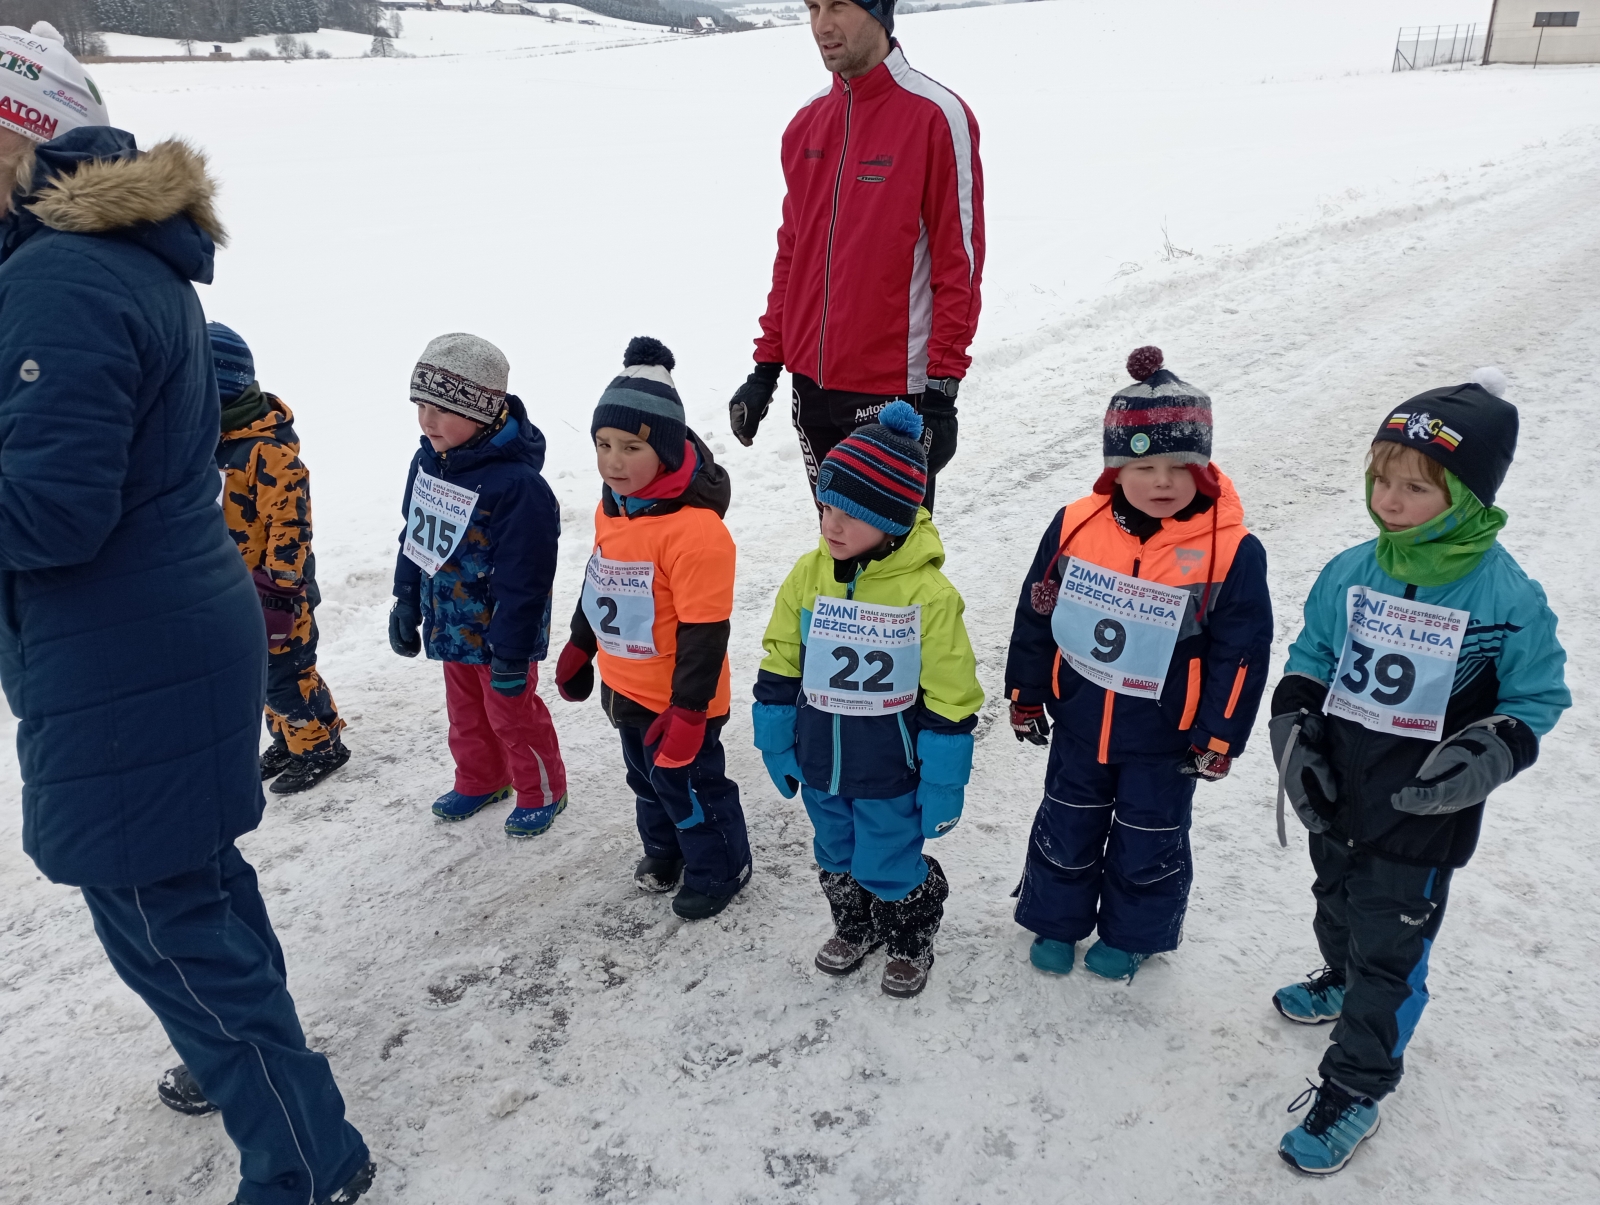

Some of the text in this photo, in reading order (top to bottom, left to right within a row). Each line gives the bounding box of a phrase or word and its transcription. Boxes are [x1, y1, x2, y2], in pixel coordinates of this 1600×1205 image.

[446, 502, 467, 518] LIGA
[412, 507, 457, 558] 215
[621, 578, 648, 589] LIGA
[1069, 564, 1117, 591] ZIMNÍ
[1123, 581, 1139, 590] KRÁLE
[1065, 580, 1177, 620] BĚŽECKÁ LIGA
[1117, 586, 1181, 606] 2025-2026
[596, 597, 621, 635] 2
[817, 603, 858, 620] ZIMNÍ
[860, 615, 916, 624] 2025-2026
[1387, 611, 1459, 632] 2025-2026
[1394, 606, 1409, 614] KRÁLE
[1410, 610, 1446, 621] JESTŘEBÍCH
[1448, 616, 1460, 624] HOR
[814, 618, 916, 638] BĚŽECKÁ LIGA
[1090, 619, 1126, 663] 9
[1410, 629, 1454, 649] LIGA
[829, 646, 894, 692] 22
[1341, 640, 1416, 706] 39
[1123, 677, 1159, 688] MARATON
[1393, 716, 1437, 727] MARATON
